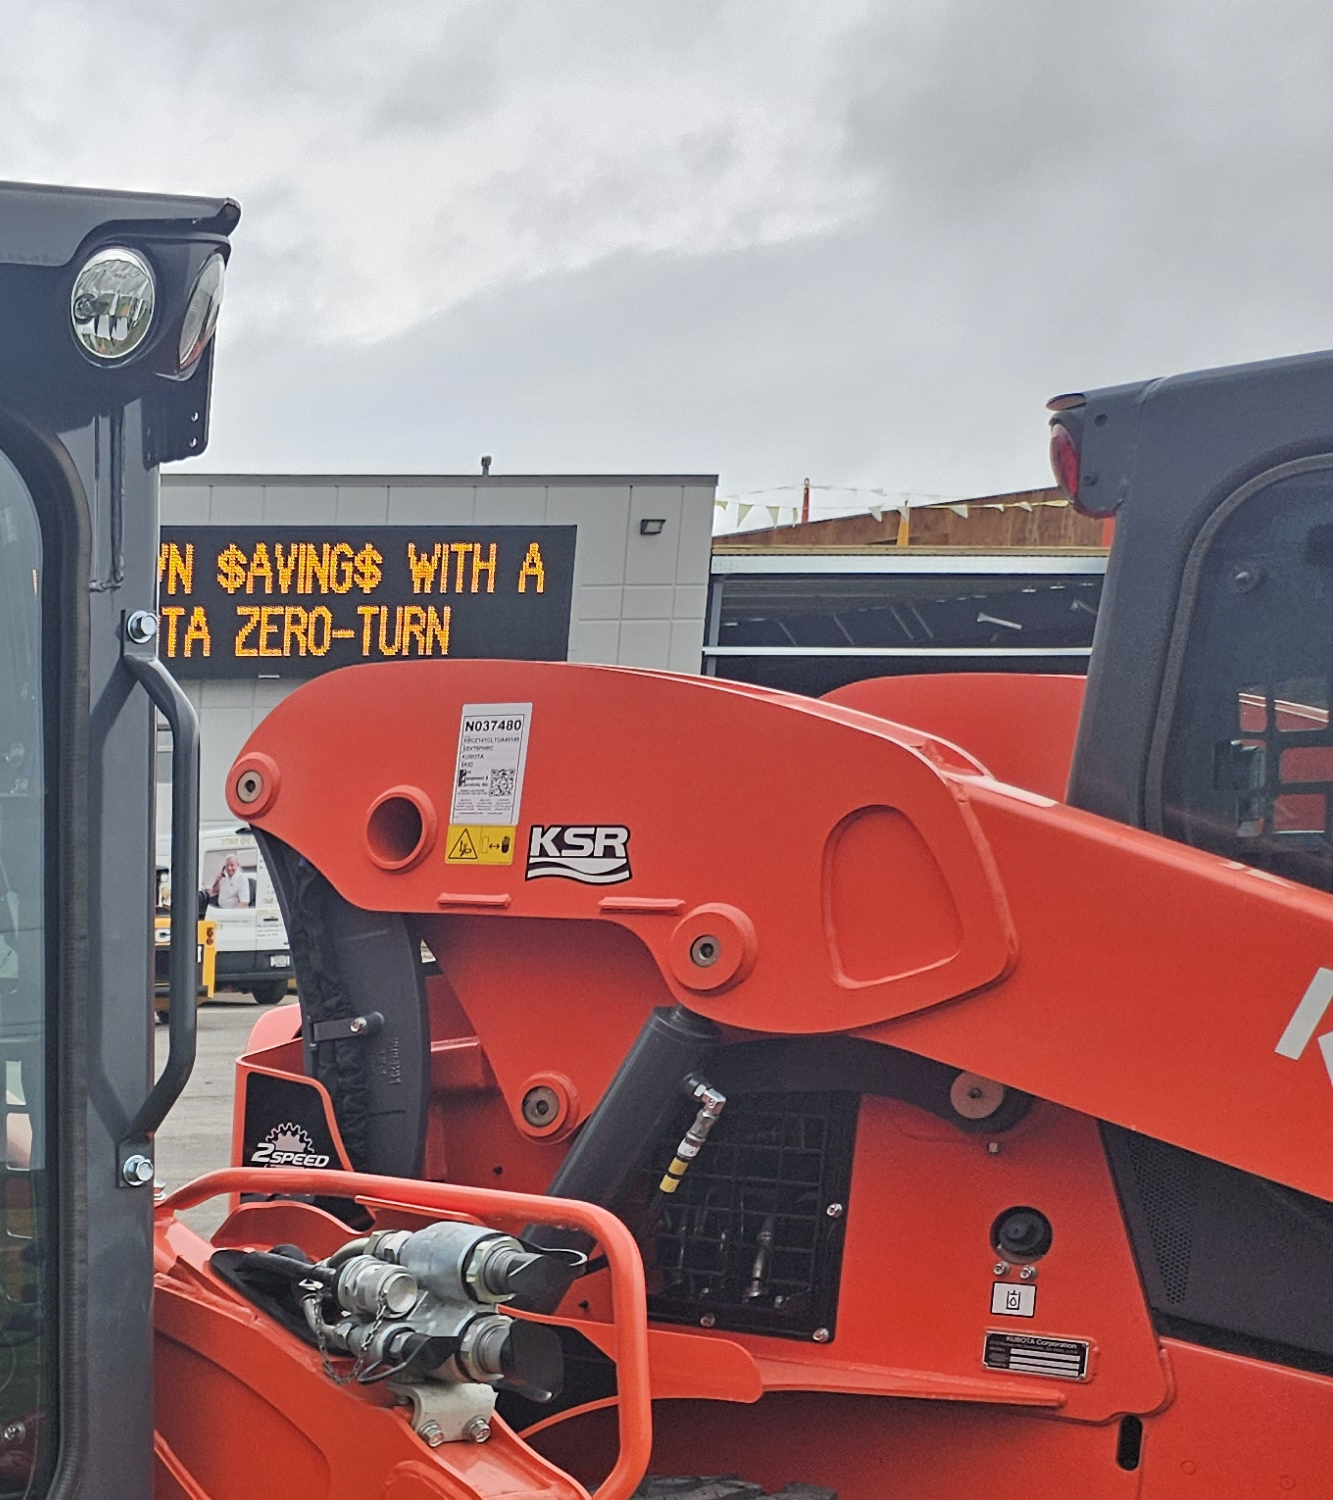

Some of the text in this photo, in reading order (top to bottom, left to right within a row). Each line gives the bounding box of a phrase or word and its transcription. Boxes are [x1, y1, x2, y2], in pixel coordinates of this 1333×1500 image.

[408, 542, 497, 594] WITH
[518, 542, 546, 594] A
[234, 605, 452, 657] ZERO-TURN
[464, 719, 523, 732] N037480
[529, 826, 629, 858] KSR
[1005, 1336, 1035, 1346] KUBOTA
[1036, 1339, 1078, 1350] Corporation
